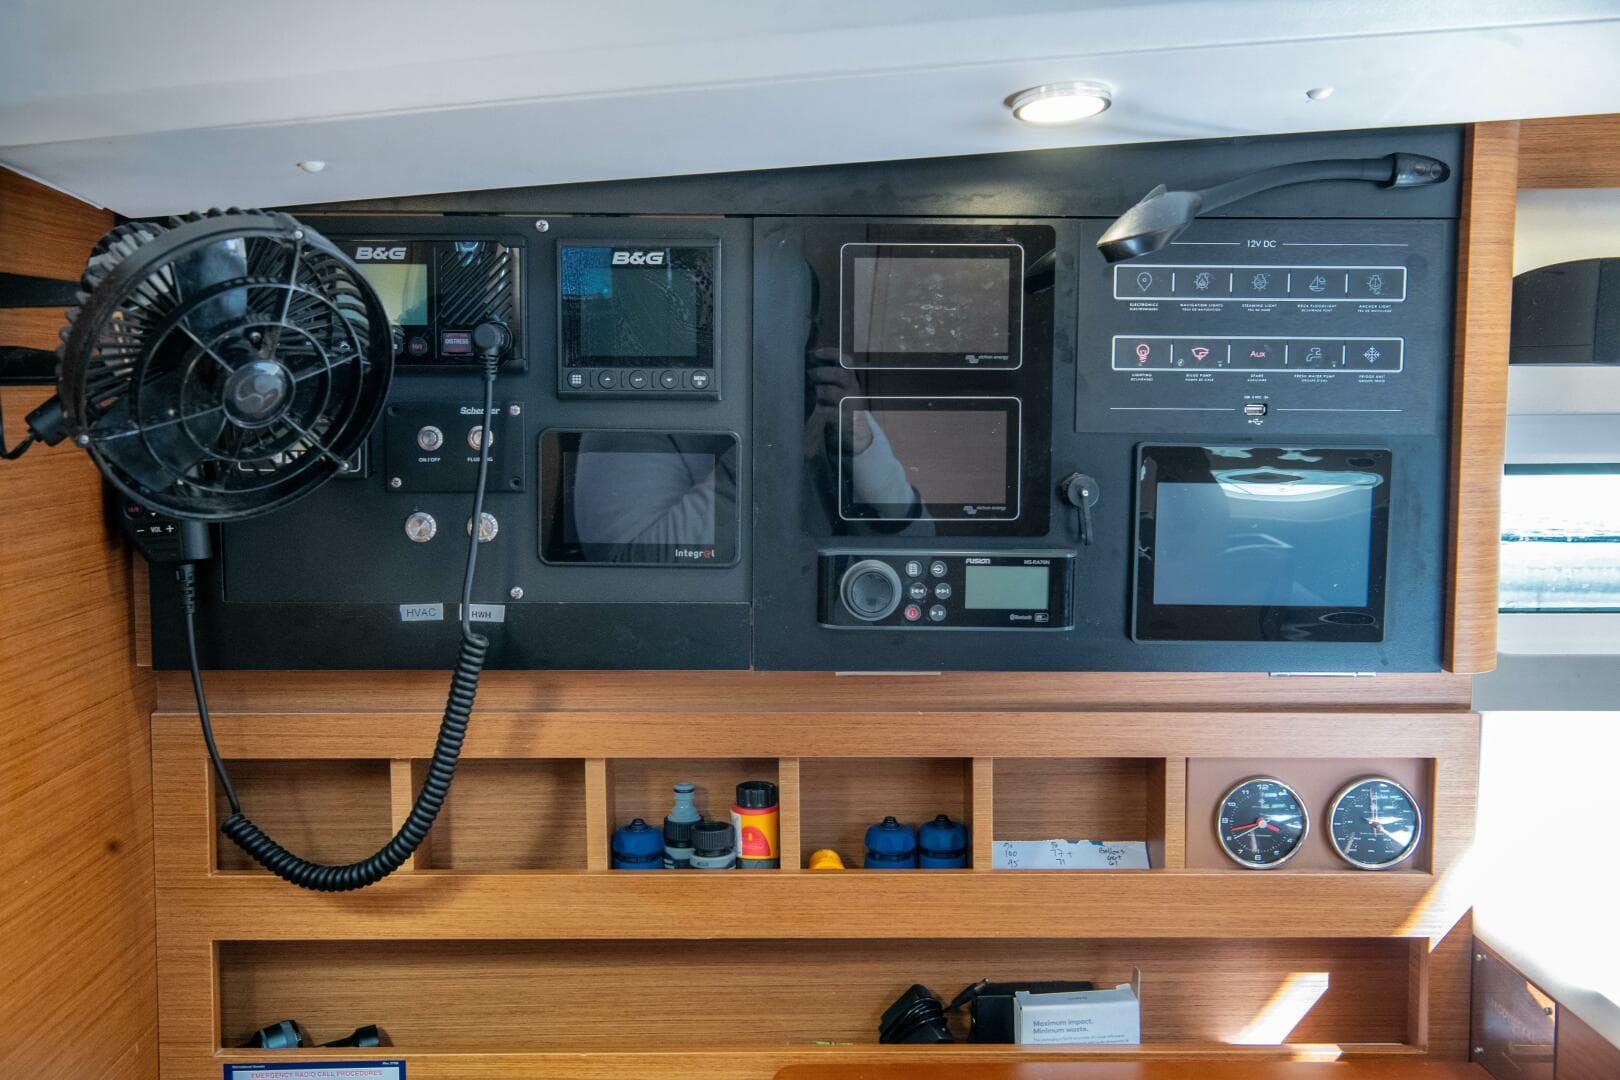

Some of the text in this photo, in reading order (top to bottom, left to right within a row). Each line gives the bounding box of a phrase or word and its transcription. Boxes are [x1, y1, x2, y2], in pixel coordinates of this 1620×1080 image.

[1247, 240, 1277, 248] 12V DC
[355, 247, 407, 260] B&G
[611, 251, 665, 265] B&G
[406, 608, 436, 617] HVAC
[471, 610, 492, 619] HWH
[1033, 1018, 1094, 1027] Maximum impact.
